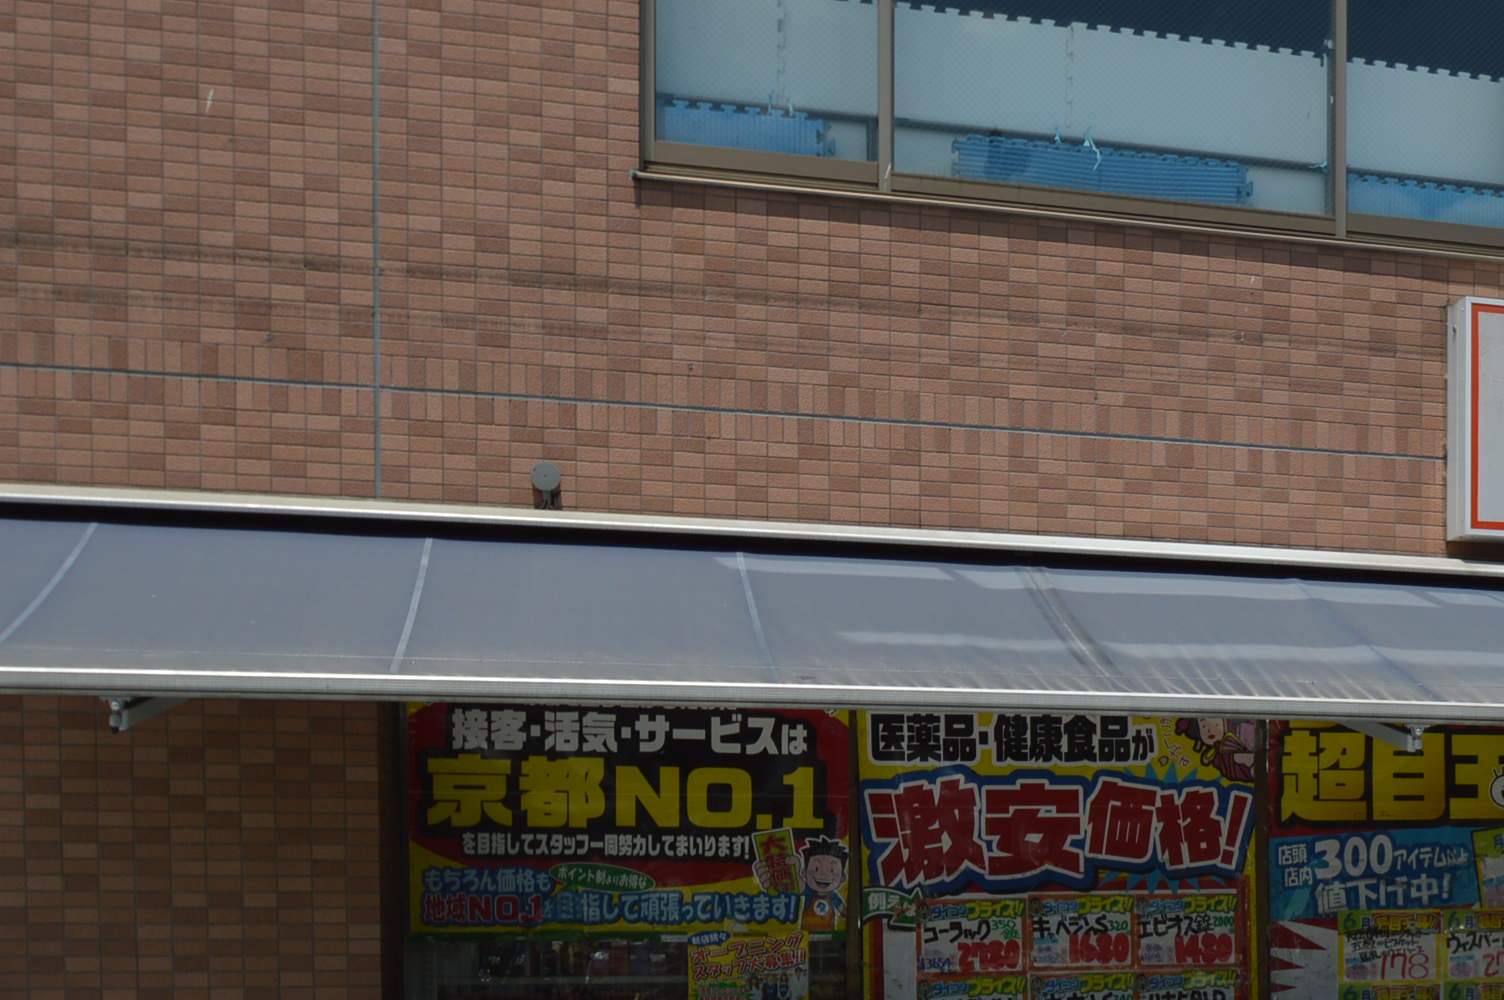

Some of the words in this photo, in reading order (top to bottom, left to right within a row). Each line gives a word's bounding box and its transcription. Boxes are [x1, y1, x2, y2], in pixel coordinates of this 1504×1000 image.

[451, 710, 808, 756] 接客・活気・サービスは
[870, 712, 1156, 764] 医薬品・健康食品が
[425, 752, 825, 830] 京都NO.1
[462, 832, 752, 860] を目指してスタッフ一同努力してまいります!
[865, 773, 1253, 888] 激安価格!
[1278, 843, 1308, 866] 店頭
[422, 865, 552, 894] もちろん価格も
[1284, 866, 1313, 888] 店内
[1316, 872, 1451, 914] 値下げ中!
